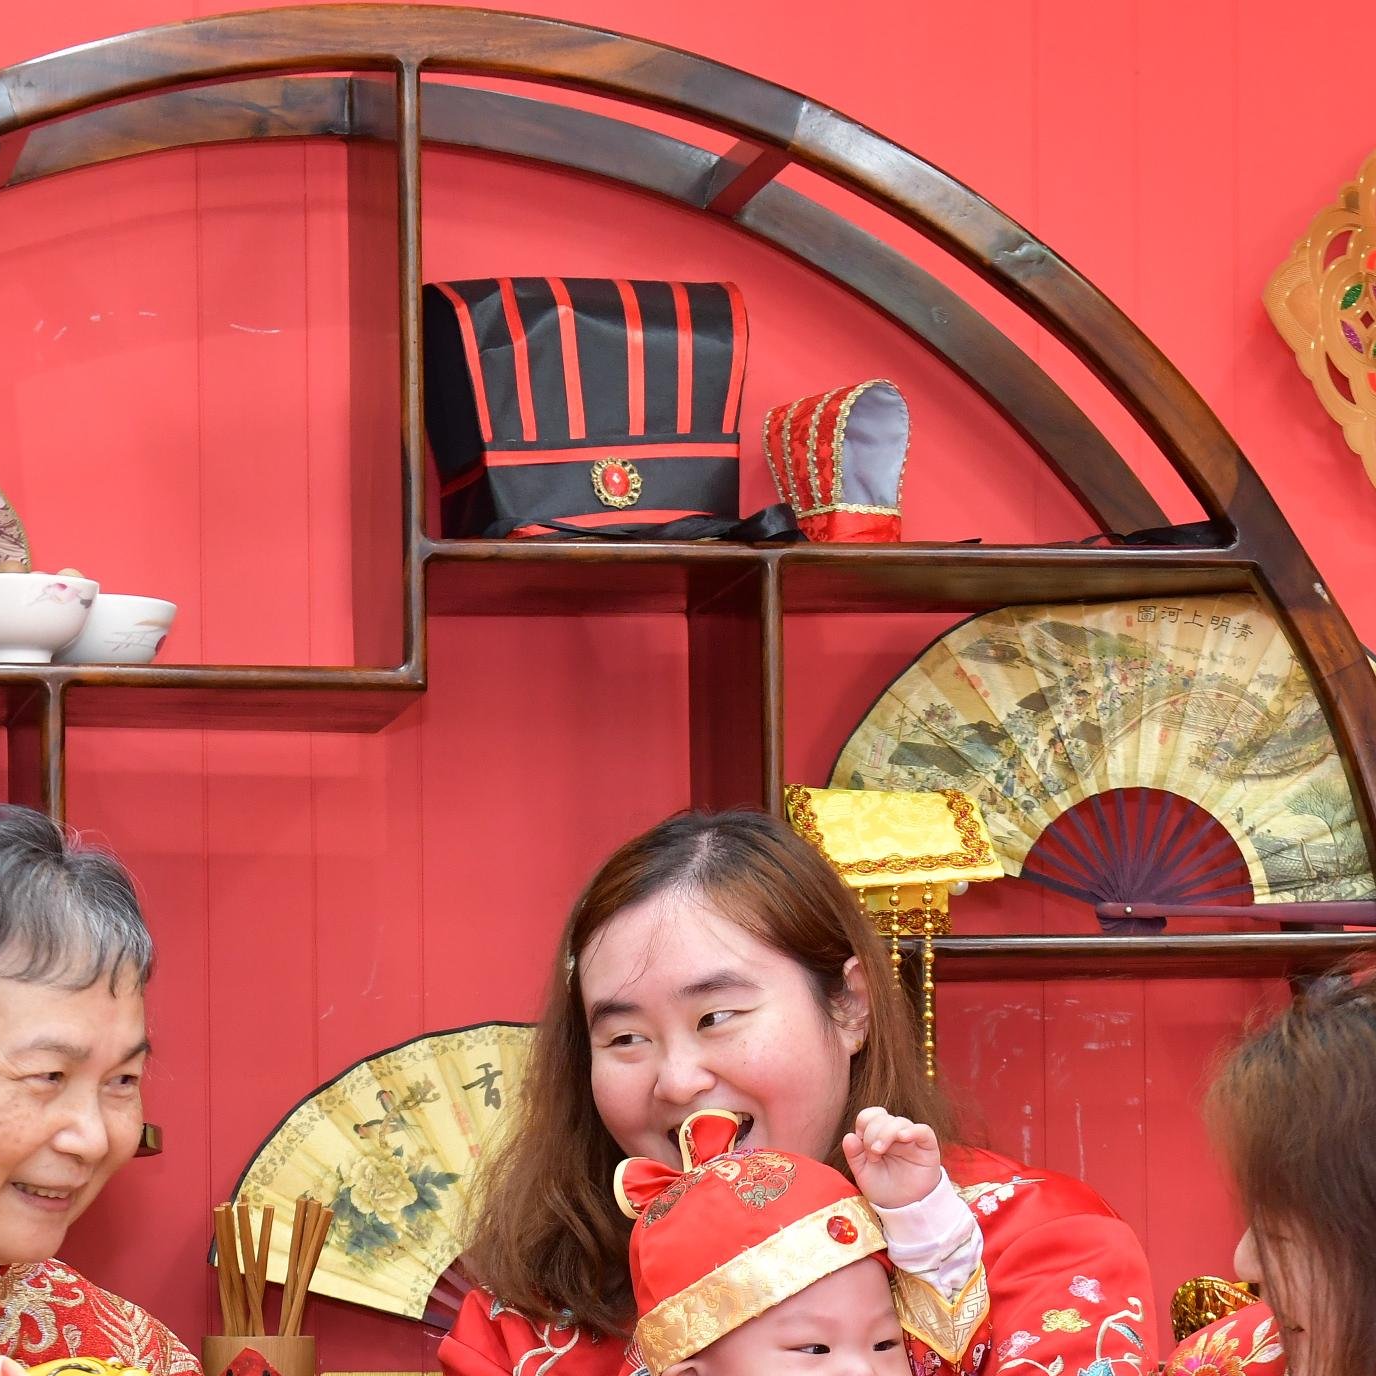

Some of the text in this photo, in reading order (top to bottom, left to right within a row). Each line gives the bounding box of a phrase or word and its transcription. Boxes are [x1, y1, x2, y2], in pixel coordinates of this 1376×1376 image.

[1137, 605, 1255, 641] 清明上河圖
